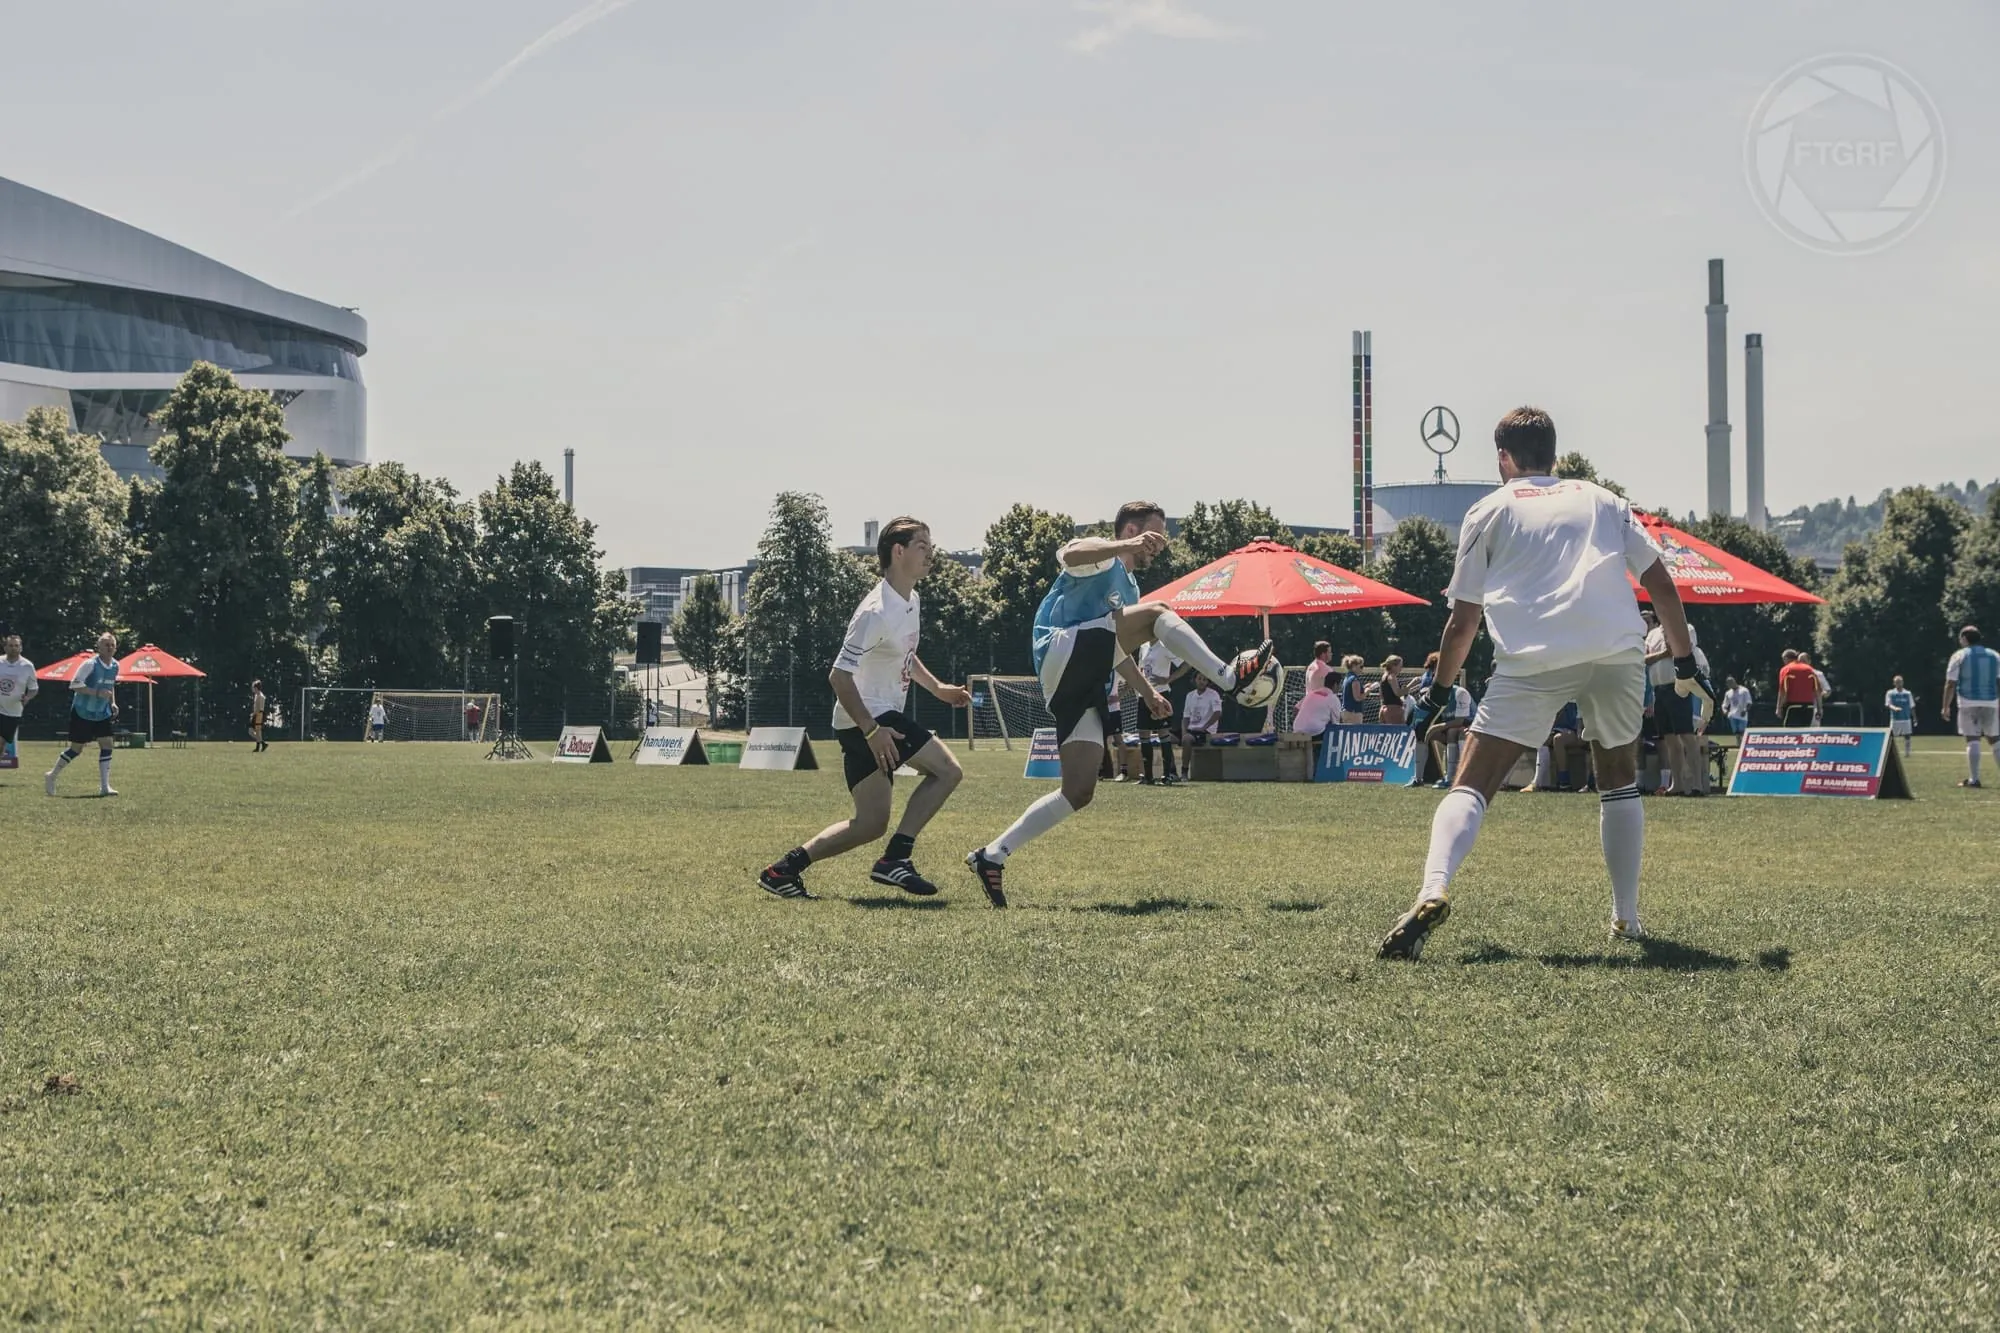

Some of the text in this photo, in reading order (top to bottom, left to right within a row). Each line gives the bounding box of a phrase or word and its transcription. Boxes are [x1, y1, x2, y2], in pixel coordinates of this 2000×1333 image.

[643, 734, 684, 748] handwerk
[1747, 733, 1858, 746] Einsatz, Technik,
[1326, 729, 1416, 769] HANDWERKER
[1745, 747, 1815, 759] Teamgeist:
[1353, 754, 1384, 766] CUP
[1739, 761, 1867, 773] genau wie bei uns.
[1805, 777, 1868, 787] DAS HANDWERK
